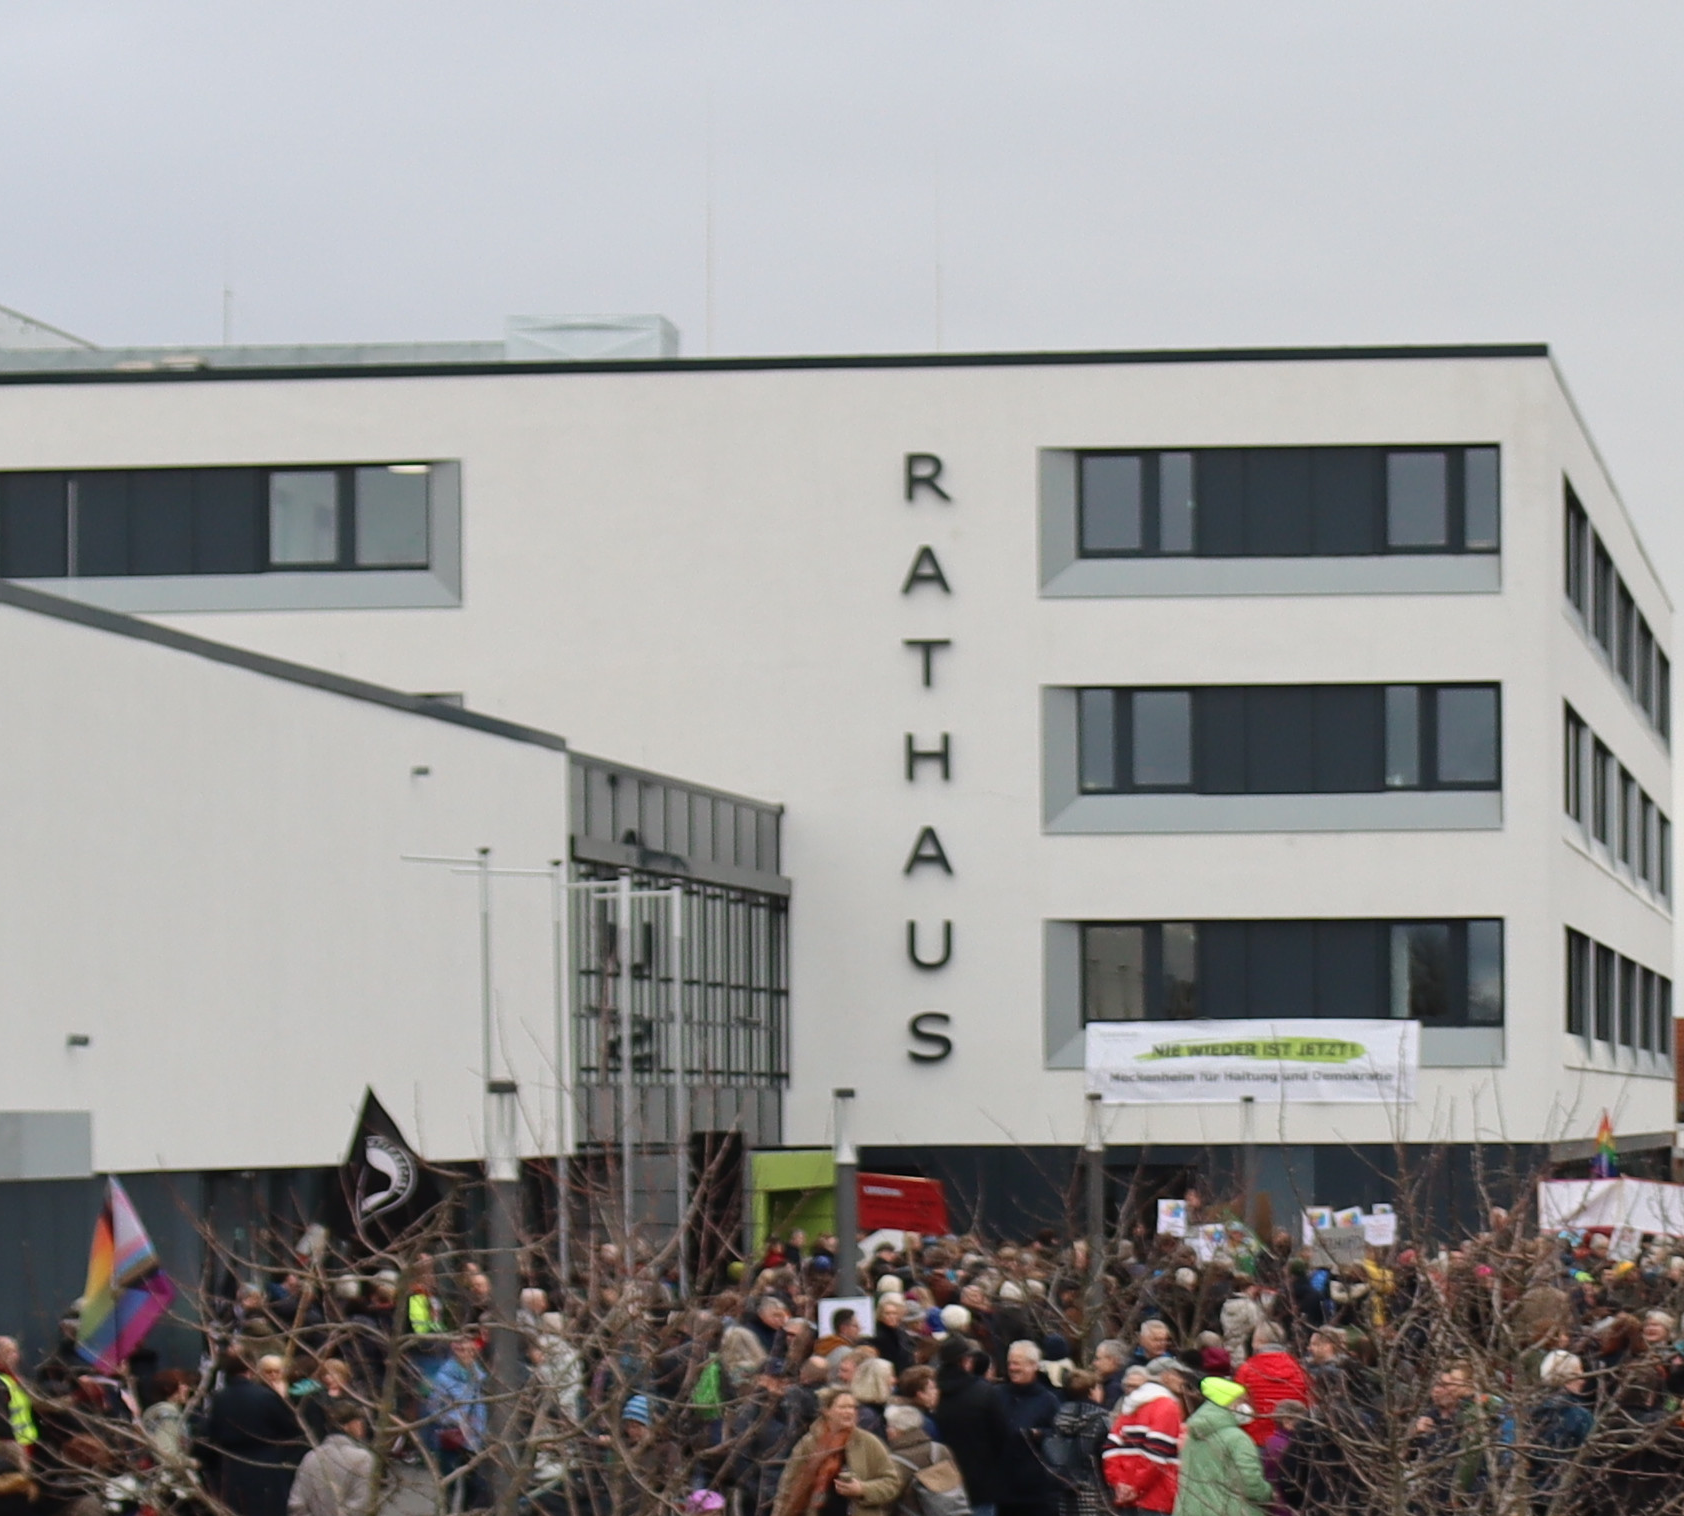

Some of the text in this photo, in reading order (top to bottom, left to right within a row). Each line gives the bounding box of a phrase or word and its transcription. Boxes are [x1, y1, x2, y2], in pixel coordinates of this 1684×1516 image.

[902, 452, 954, 1067] RATHAUS
[1152, 1043, 1181, 1057] NIE
[1187, 1043, 1257, 1057] WIEDER
[1261, 1043, 1291, 1056] IST
[1223, 1071, 1278, 1085] Haltung
[1281, 1071, 1309, 1083] und
